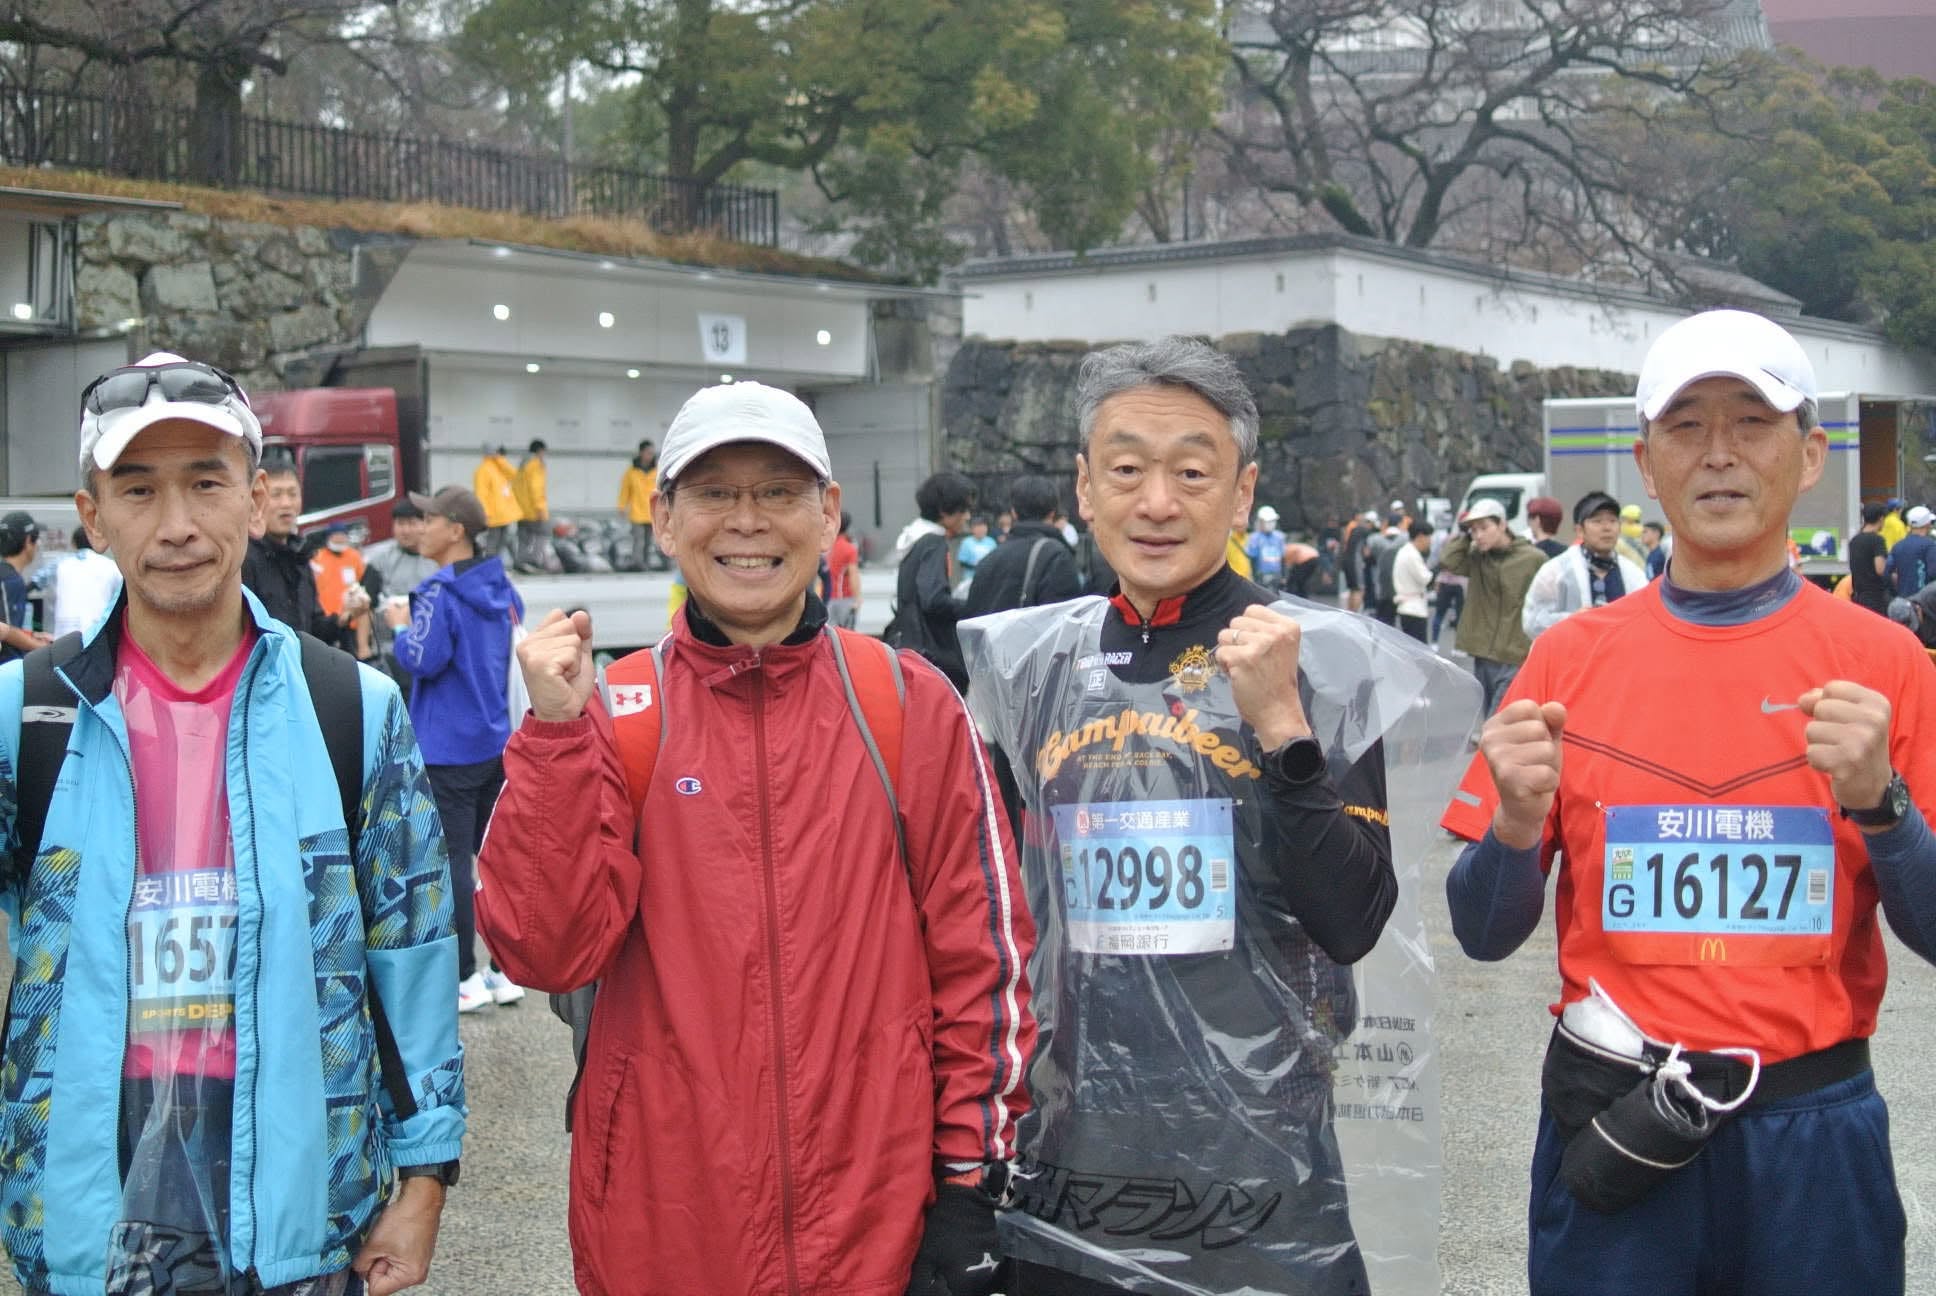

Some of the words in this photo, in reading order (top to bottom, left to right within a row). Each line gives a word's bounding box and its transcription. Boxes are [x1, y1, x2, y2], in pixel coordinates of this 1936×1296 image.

[1091, 809, 1192, 831] 第一交通産業
[1658, 809, 1775, 840] 安川電機
[1079, 845, 1205, 910] 12998
[1608, 884, 1635, 918] G
[1646, 852, 1802, 920] 16127
